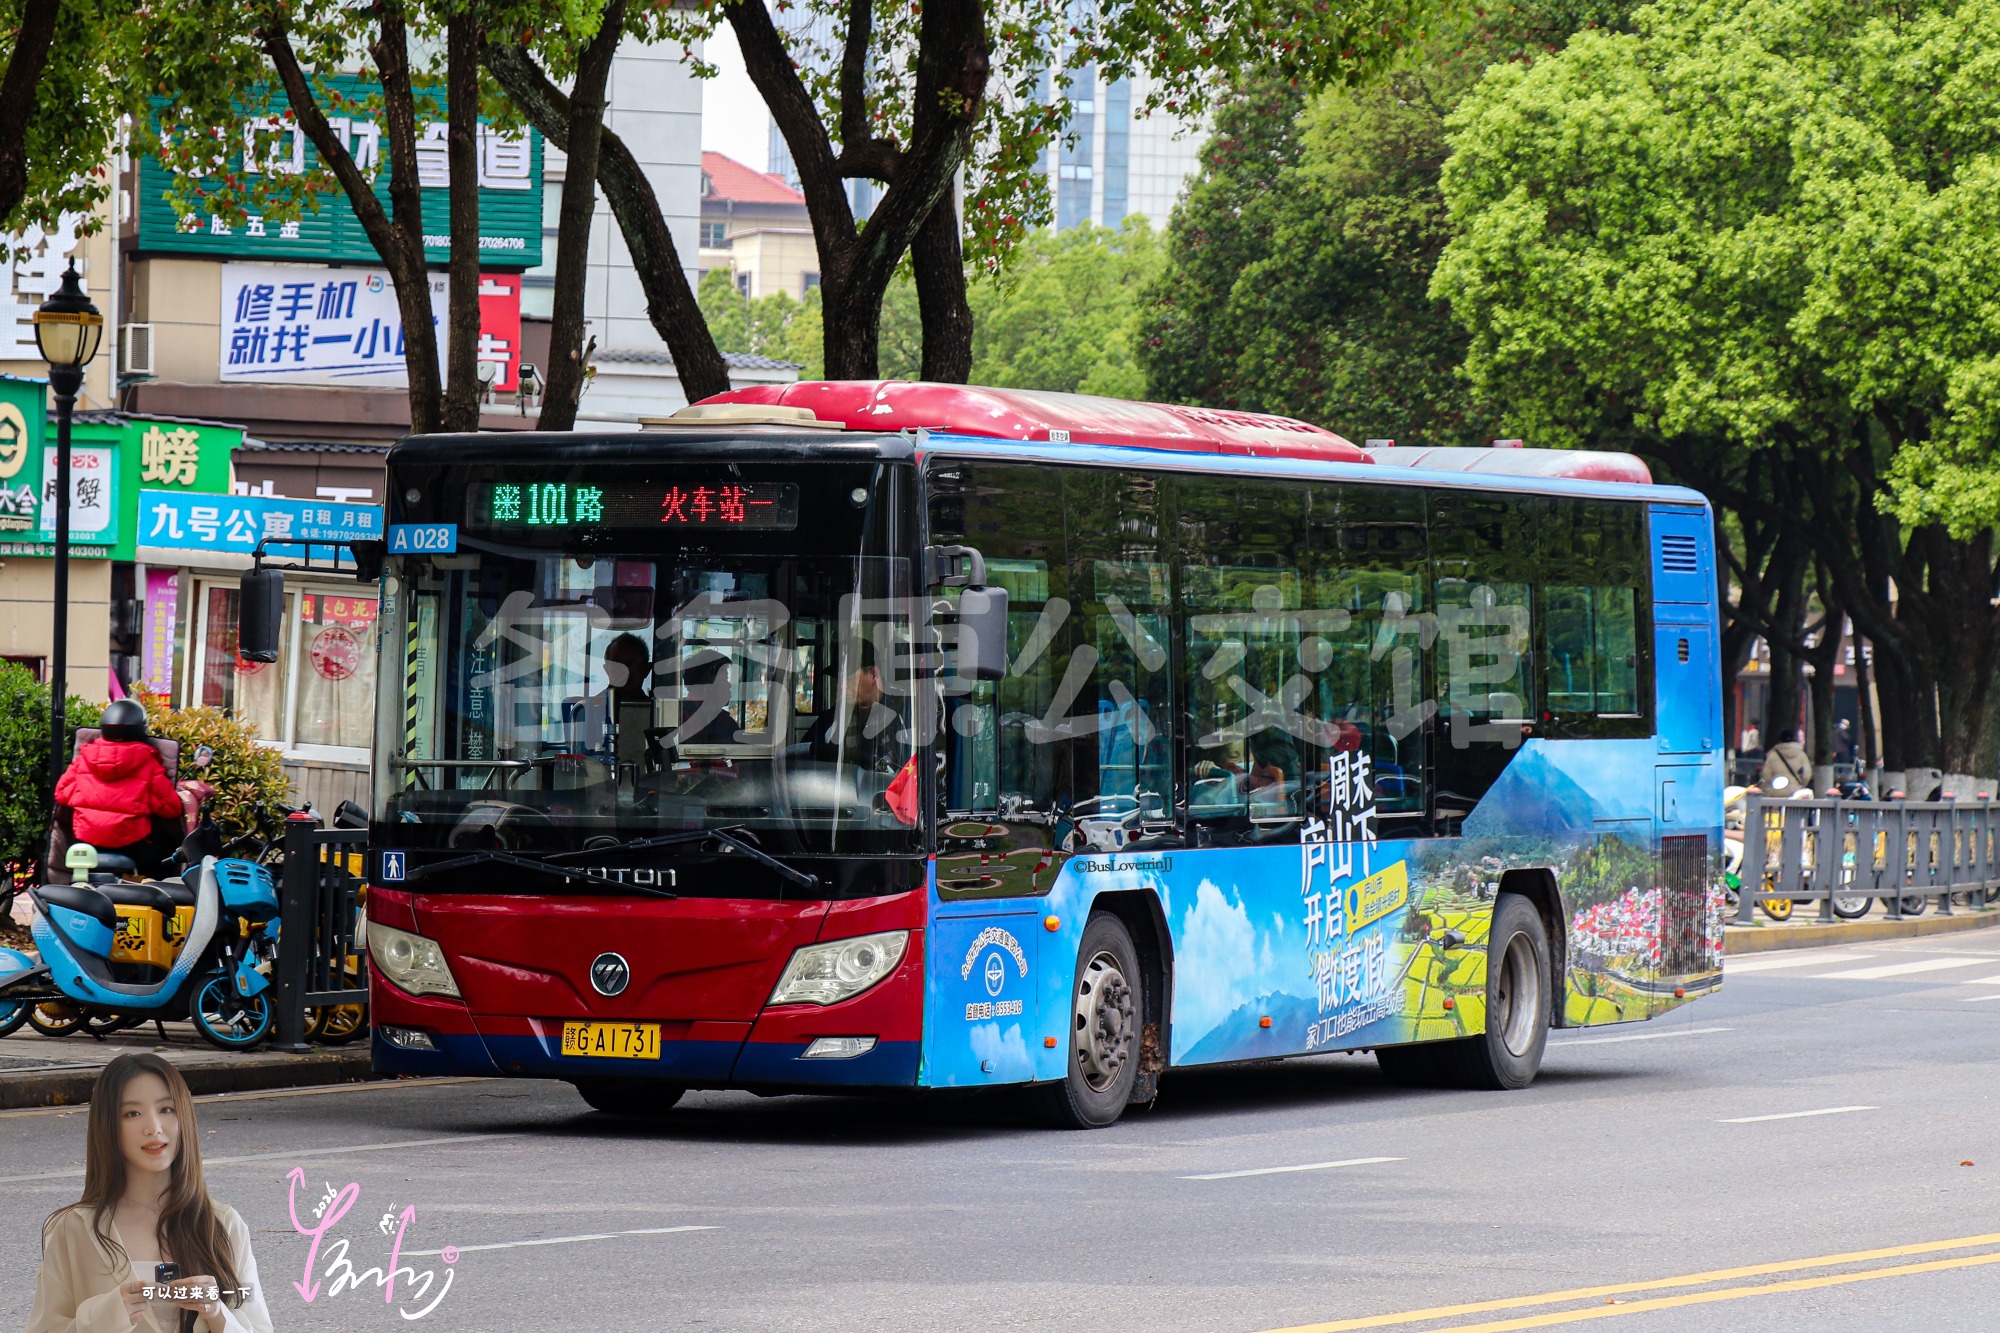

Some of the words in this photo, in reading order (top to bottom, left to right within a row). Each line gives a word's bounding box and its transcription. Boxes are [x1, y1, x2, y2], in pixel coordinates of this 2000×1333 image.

[235, 281, 357, 322] 修手机
[141, 425, 200, 486] 螃
[150, 503, 295, 547] 九号公寓
[302, 509, 331, 525] 日租
[341, 511, 372, 528] 月租
[394, 528, 408, 550] A
[413, 528, 449, 549] 028
[1329, 750, 1374, 815] 周末
[1300, 805, 1377, 897] 庐山下
[1303, 886, 1343, 949] 开启
[1316, 932, 1386, 1015] 微度假
[1305, 987, 1407, 1050] 家门口也能玩出高级感
